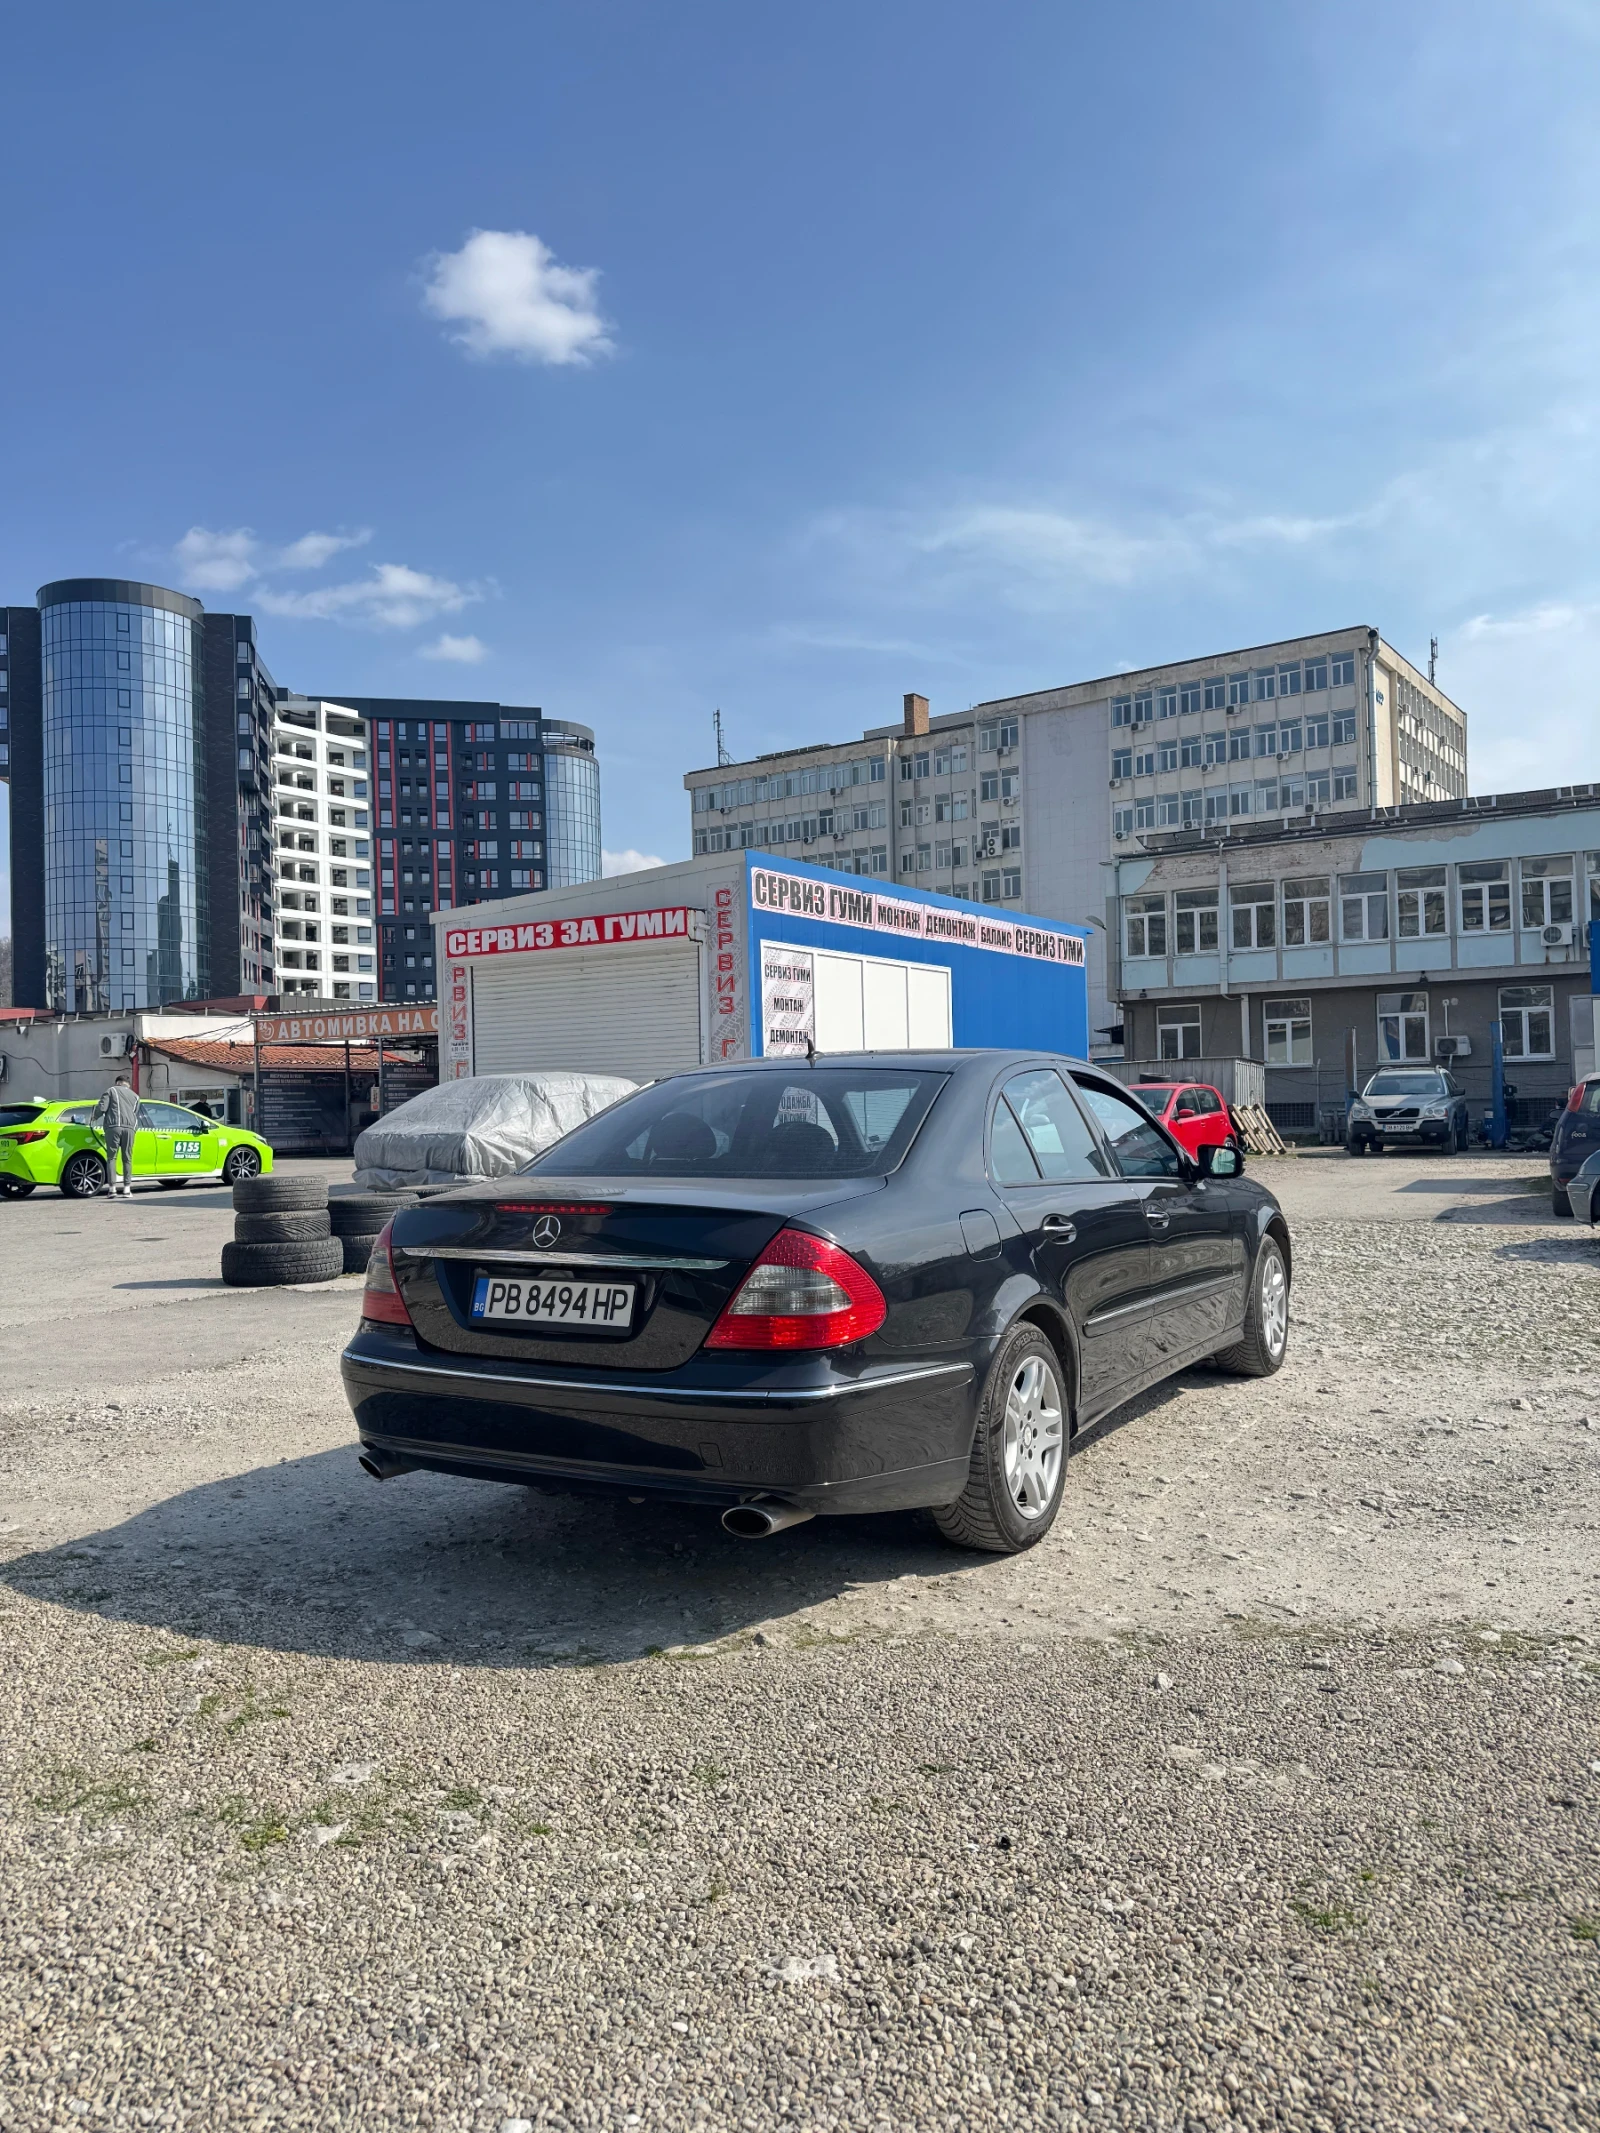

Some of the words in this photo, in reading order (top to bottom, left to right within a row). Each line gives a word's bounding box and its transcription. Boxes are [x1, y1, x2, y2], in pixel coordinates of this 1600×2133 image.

[755, 872, 825, 915] СЕРВИЗ
[829, 888, 873, 924] ГУМИ
[877, 905, 921, 931] МОНТАЖ
[925, 915, 976, 940] ДЕМОНТАЖ
[981, 926, 1012, 948] БАЛАНС
[1015, 929, 1056, 959] СЕРВИЗ
[1058, 938, 1083, 963] ГУМИ
[448, 923, 554, 955] СЕРВИЗ
[560, 919, 599, 944] ЗА
[604, 909, 685, 940] ГУМИ
[715, 889, 736, 1015] СЕРВИЗ
[764, 964, 792, 980] СЕРВИЗ
[793, 967, 811, 982] ГУМИ
[773, 997, 804, 1012] МОНТАЖ
[278, 1014, 393, 1039] АВТОМИВКА
[397, 1012, 425, 1031] НА
[770, 1029, 809, 1044] ДЕМОНТАЖ
[175, 1142, 200, 1152] 6155
[473, 1302, 485, 1312] BG
[488, 1282, 522, 1314] PB
[525, 1284, 589, 1319] 8494
[591, 1287, 629, 1321] HP
